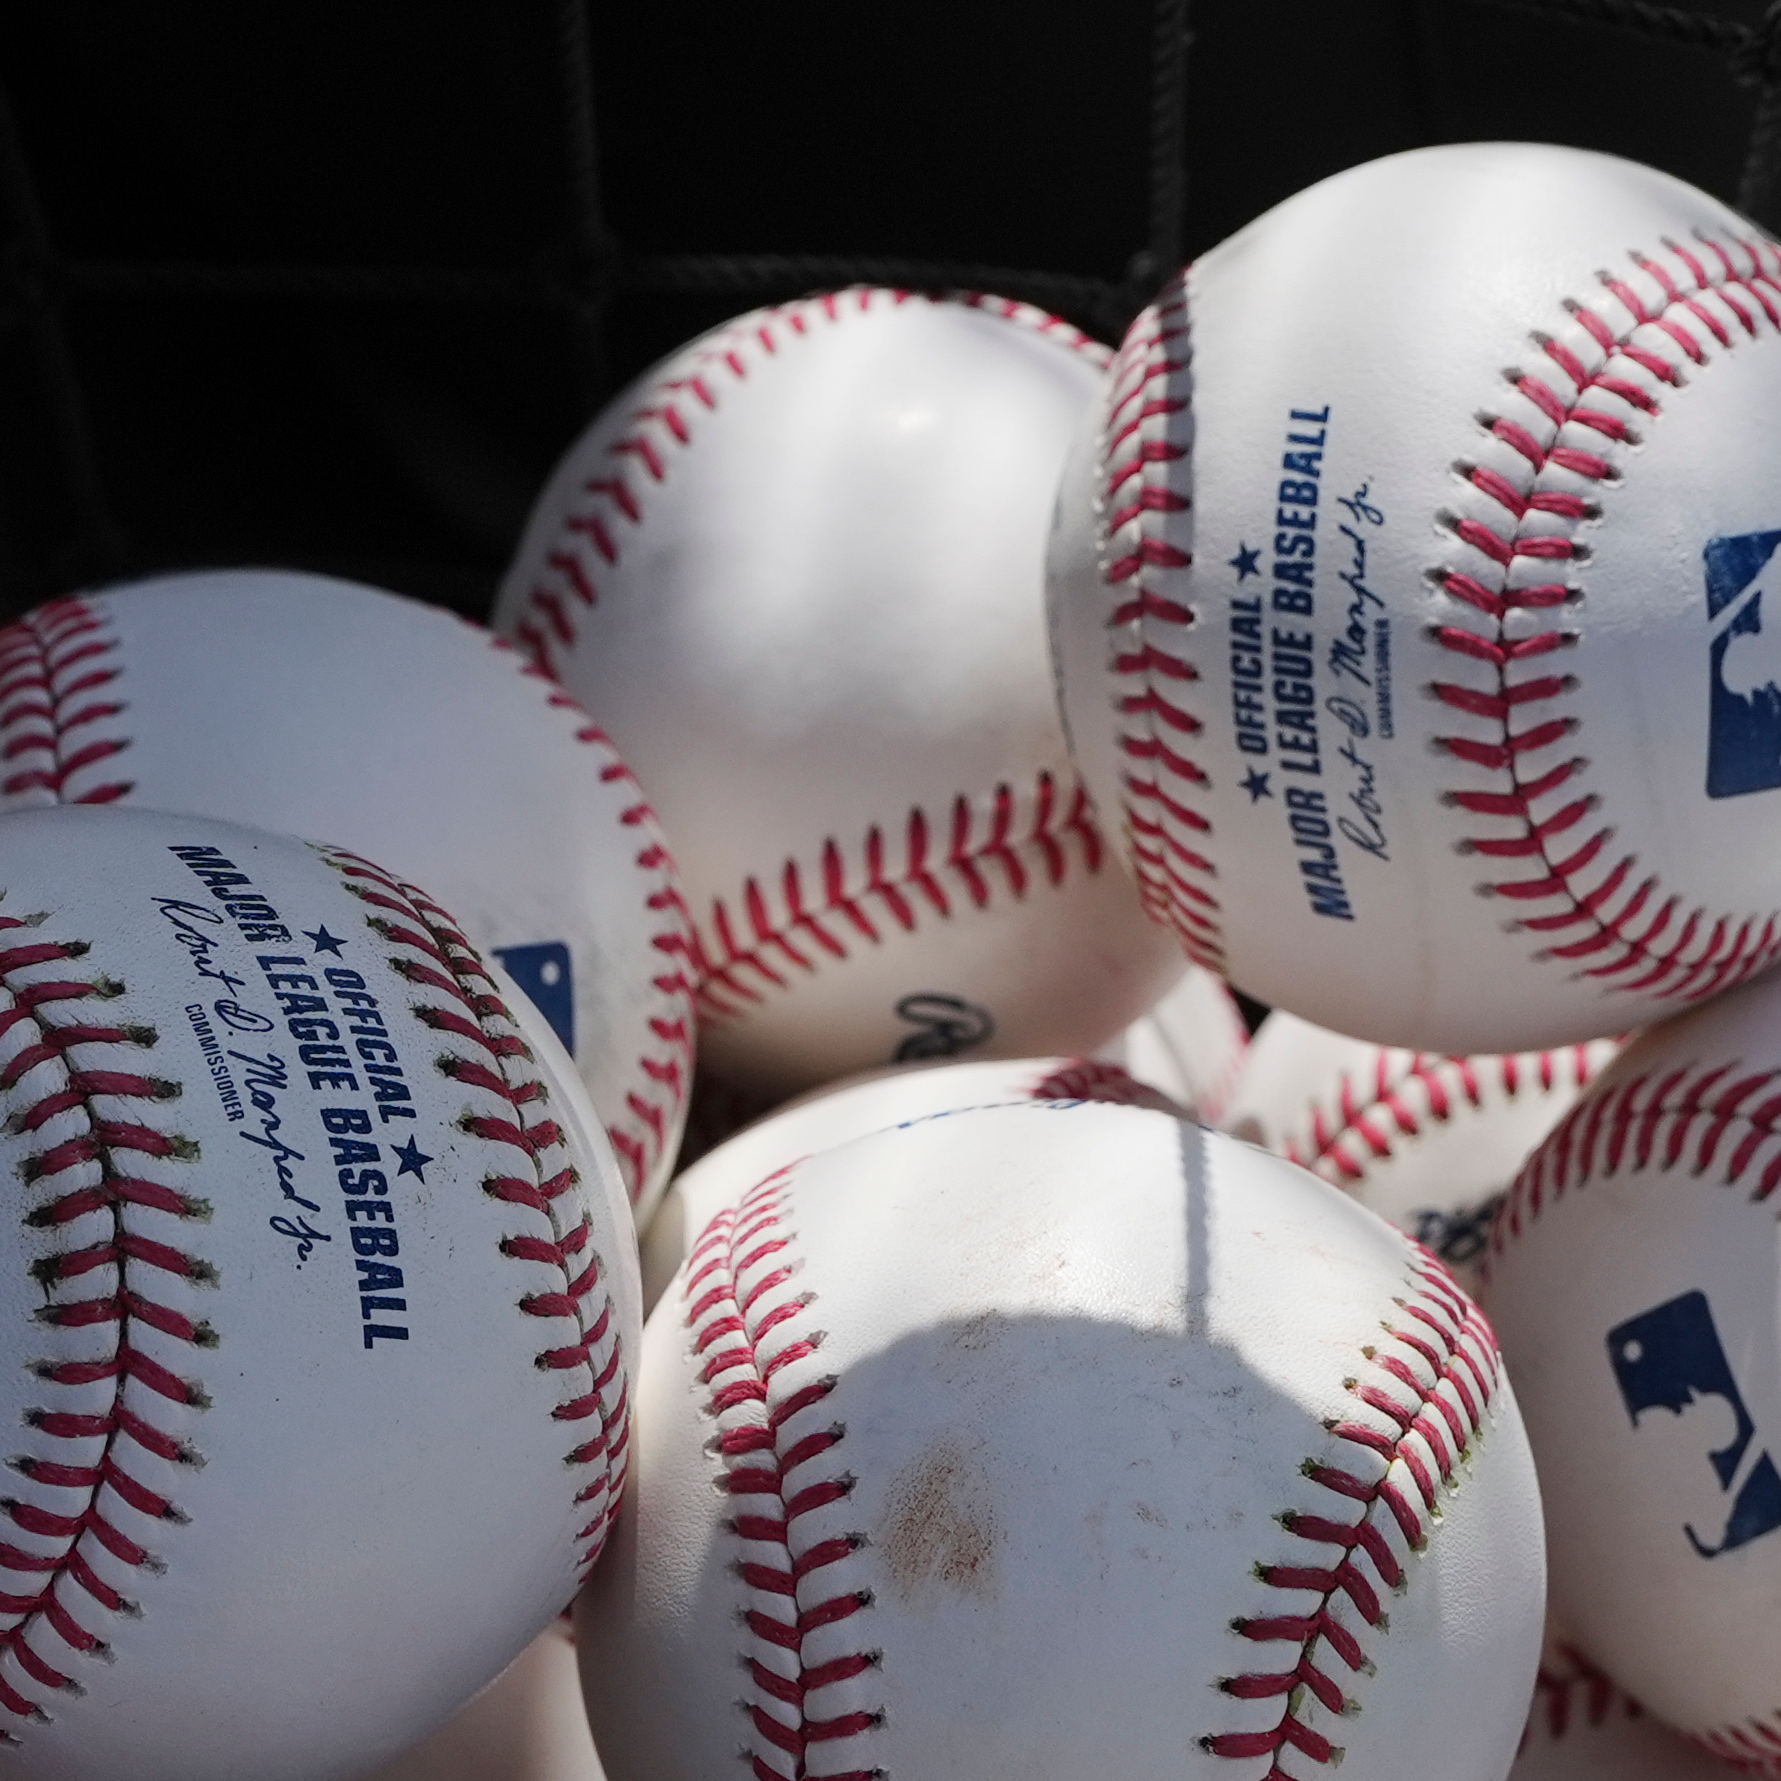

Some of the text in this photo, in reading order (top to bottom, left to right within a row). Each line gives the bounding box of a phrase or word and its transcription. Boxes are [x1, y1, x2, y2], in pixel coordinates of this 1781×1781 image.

[1229, 596, 1268, 756] OFFICIAL
[1272, 404, 1355, 922] MAJOR LEAGUE BASEBALL
[166, 845, 411, 1350] MAJOR LEAGUE BASEBALL
[184, 1002, 246, 1123] COMMISSIONER
[322, 966, 417, 1124] OFFICIAL
